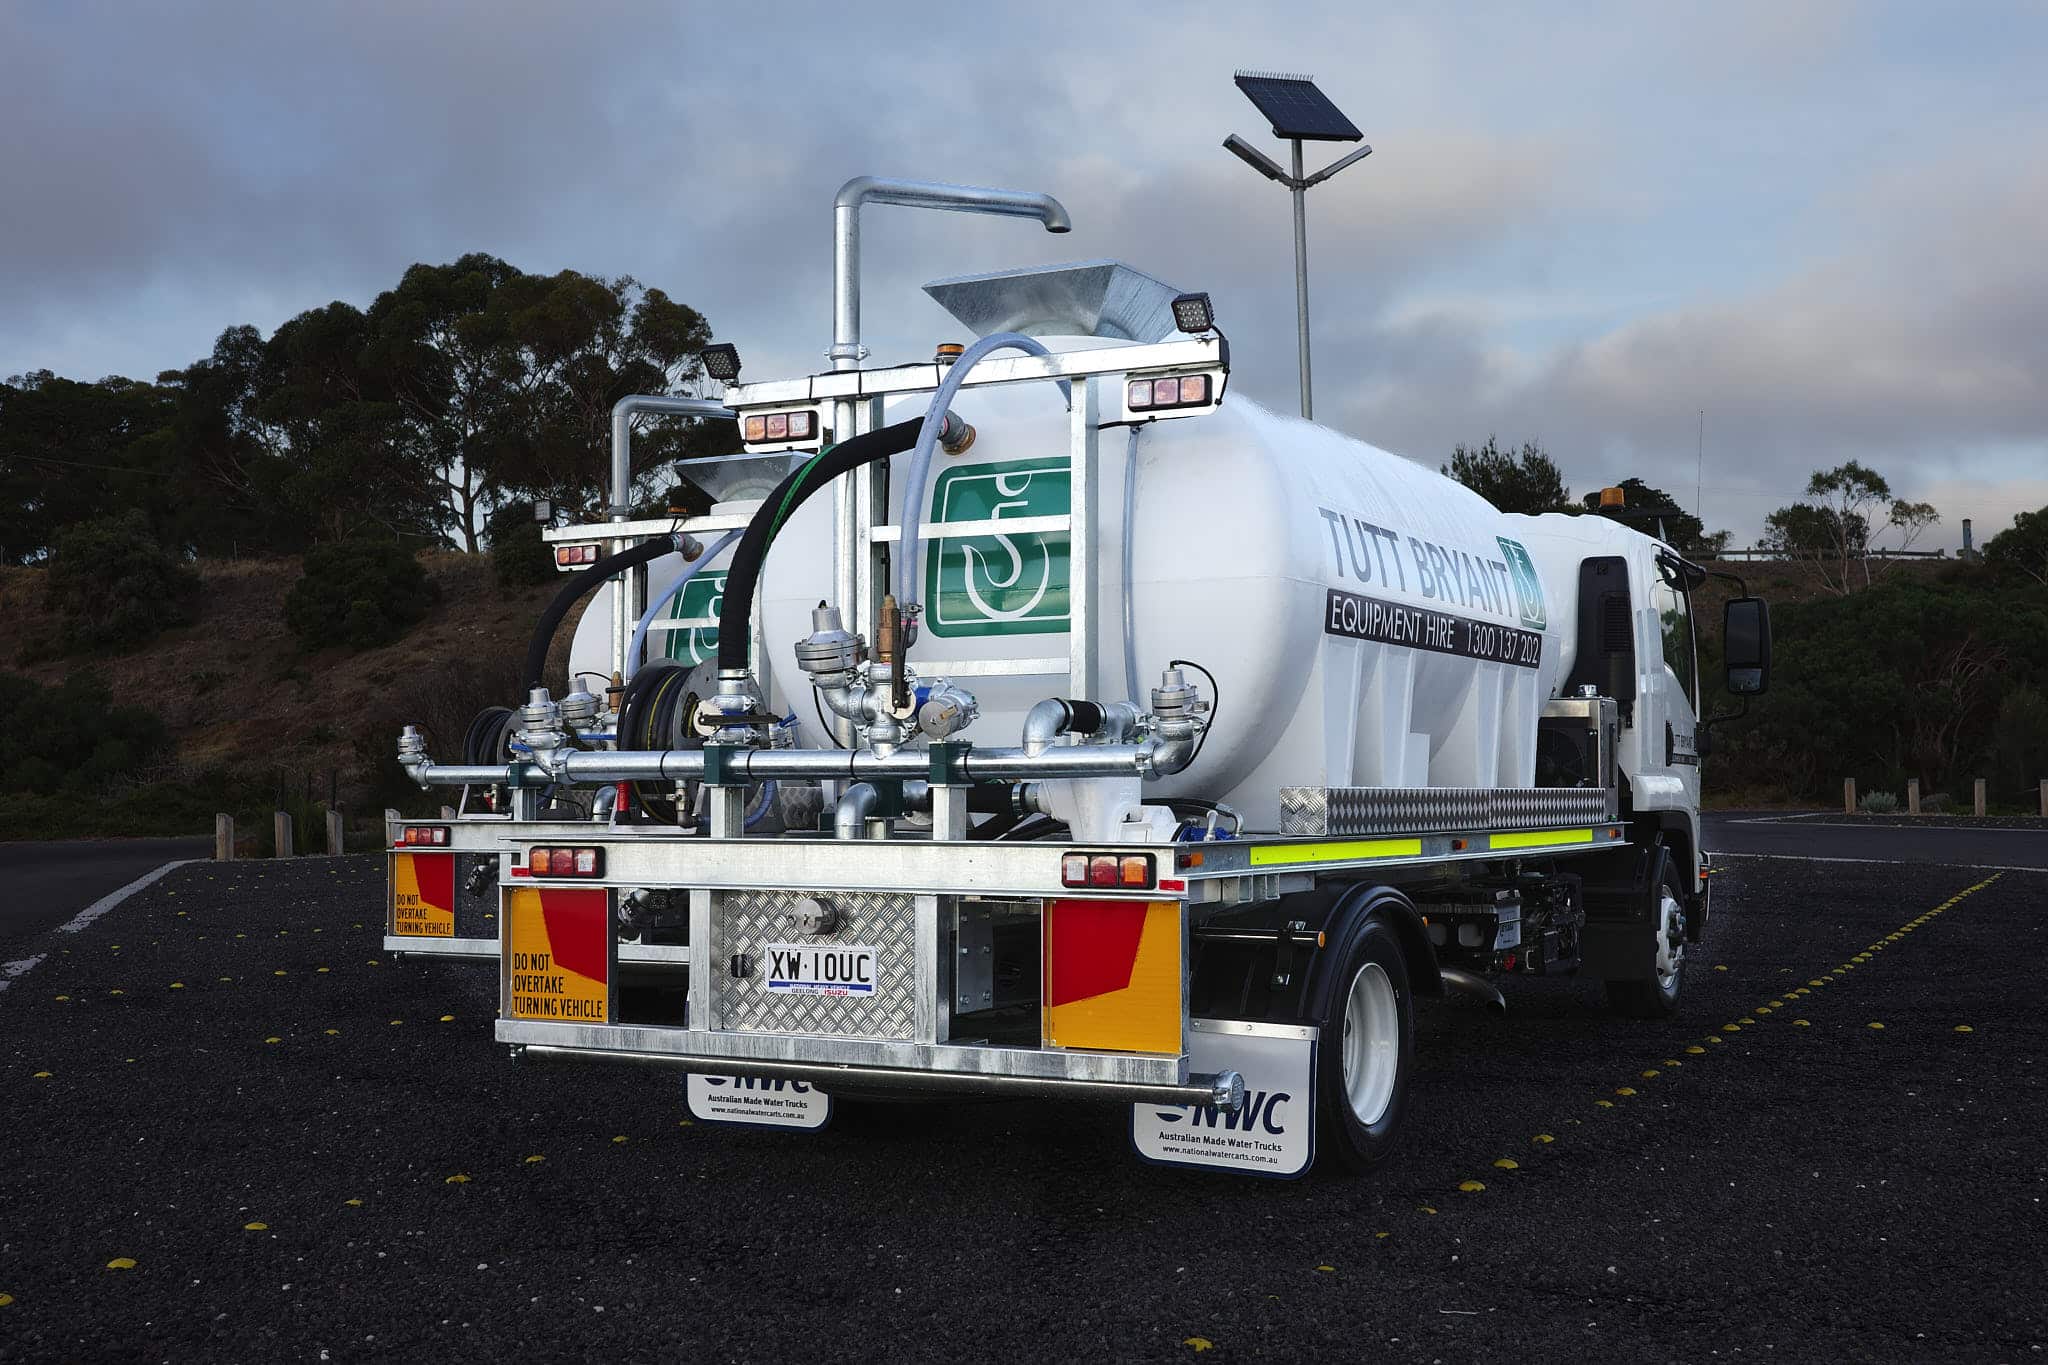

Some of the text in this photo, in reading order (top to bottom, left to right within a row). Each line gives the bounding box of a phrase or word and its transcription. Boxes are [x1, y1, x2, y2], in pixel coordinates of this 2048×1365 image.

[1319, 507, 1512, 617] TUTT BRYANT
[1331, 595, 1539, 664] EQUIPMENT HIRE 1300 137 202
[396, 894, 418, 906] DO NOT
[396, 908, 428, 920] OVERTAKE
[396, 921, 451, 935] TURNING VEHICLE
[514, 953, 550, 971] DO NOT
[514, 974, 564, 994] OVERTAKE
[514, 996, 602, 1018] TURNING VEHICLE
[708, 1094, 808, 1109] Australian Made Water Trucks
[711, 1106, 805, 1120] www.nationalwatercarts.com.au
[1159, 1131, 1282, 1152] Australian Made Water Trucks
[1162, 1146, 1278, 1164] www.nationalwatercarts.com.au
